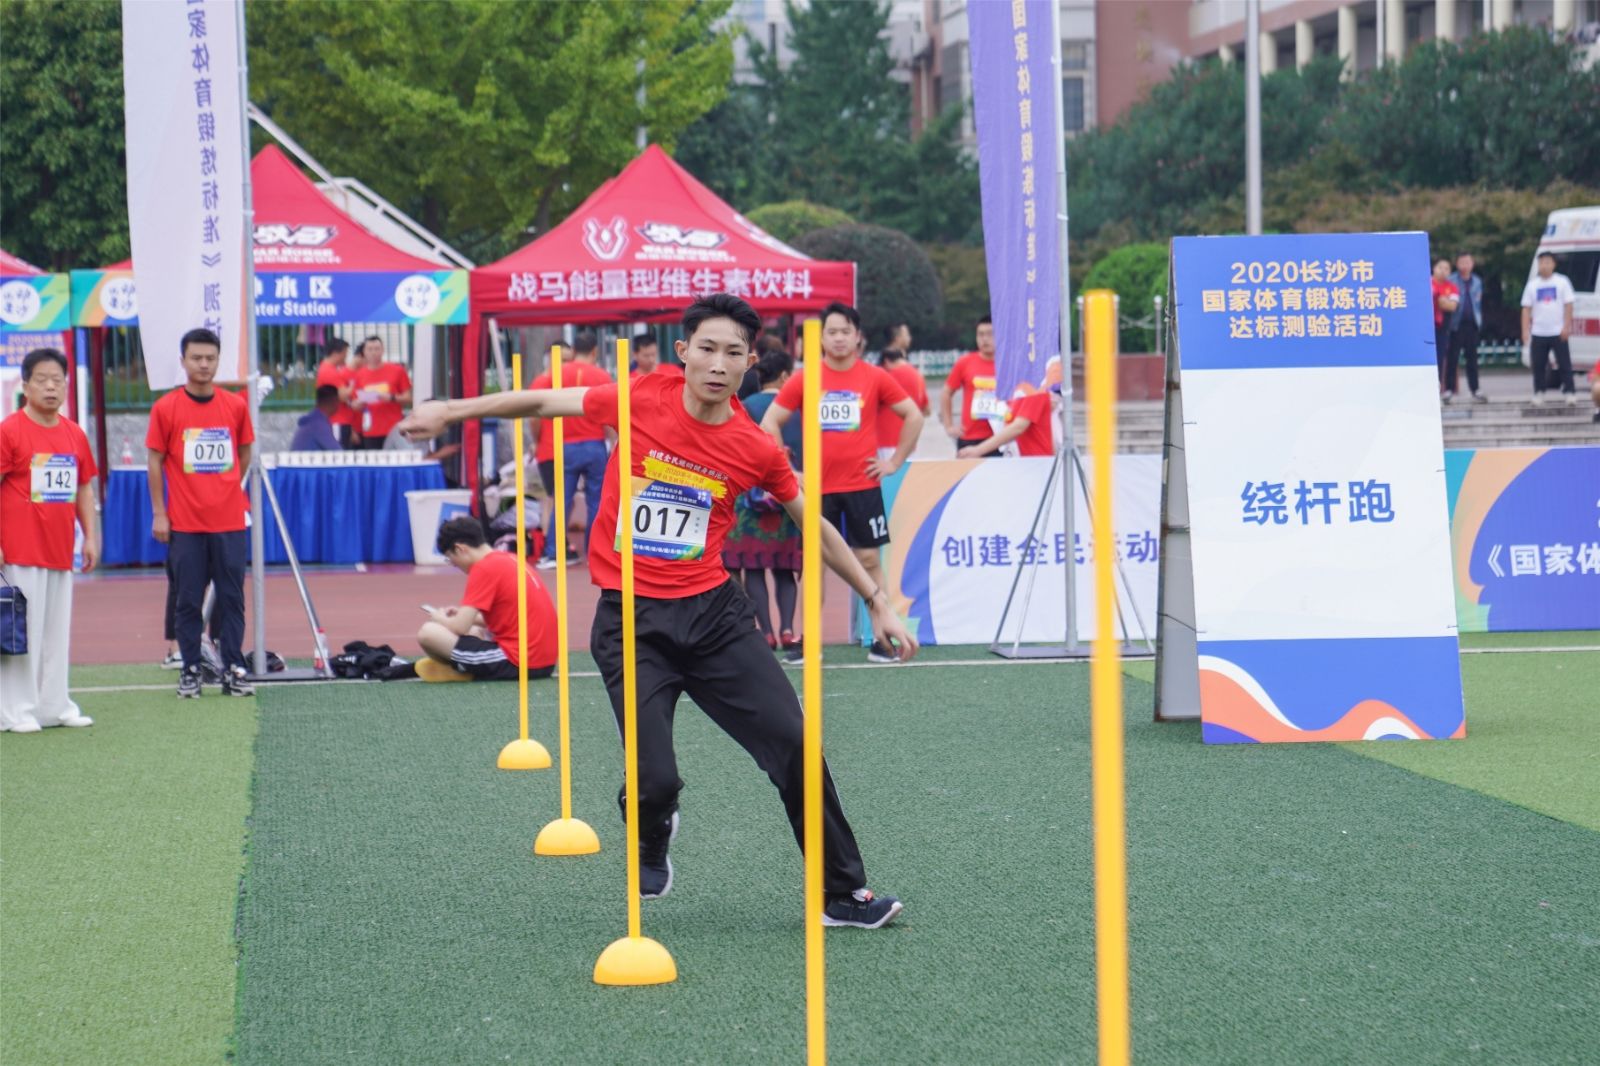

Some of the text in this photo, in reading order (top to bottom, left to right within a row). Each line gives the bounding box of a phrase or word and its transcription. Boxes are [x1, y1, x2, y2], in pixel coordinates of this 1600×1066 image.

[508, 267, 813, 302] 战马能量型维生素饮料
[1231, 260, 1374, 284] 2020长沙市
[283, 300, 337, 316] Station
[1202, 287, 1407, 313] 国家体育锻炼标准
[1230, 314, 1383, 338] 达标测验活动
[821, 404, 851, 420] 069
[195, 443, 225, 461] 070
[44, 470, 71, 489] 142
[1240, 479, 1395, 525] 绕杆跑
[634, 504, 691, 537] 017
[869, 514, 888, 540] 12
[1487, 540, 1600, 578] 《国家体
